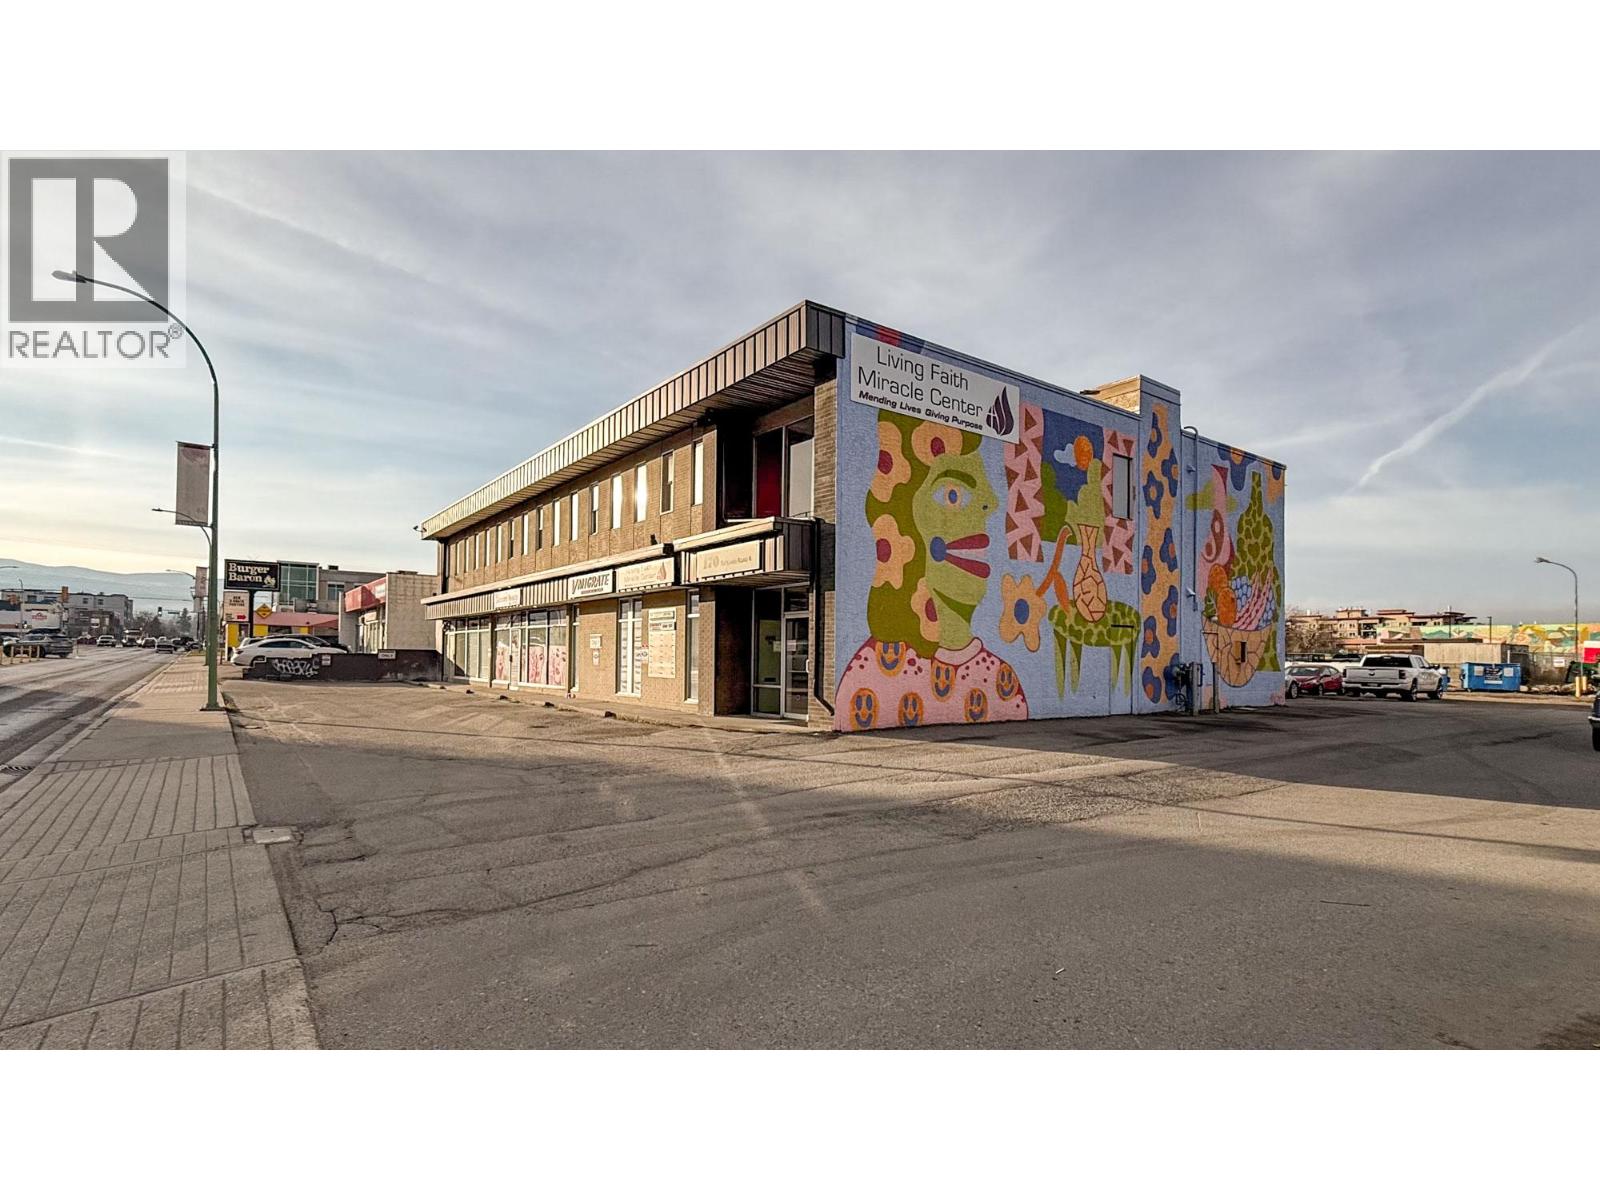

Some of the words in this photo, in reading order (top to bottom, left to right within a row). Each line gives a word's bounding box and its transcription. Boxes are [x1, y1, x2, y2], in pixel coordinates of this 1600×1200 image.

[877, 346, 924, 381] Living
[931, 363, 969, 390] Faith
[858, 366, 924, 401] Miracle
[930, 388, 983, 417] Center
[859, 390, 897, 409] Mending
[900, 401, 921, 414] Lives
[925, 408, 950, 423] Giving
[951, 415, 983, 430] Purpose
[229, 562, 270, 575] Burger
[229, 572, 263, 582] Baron
